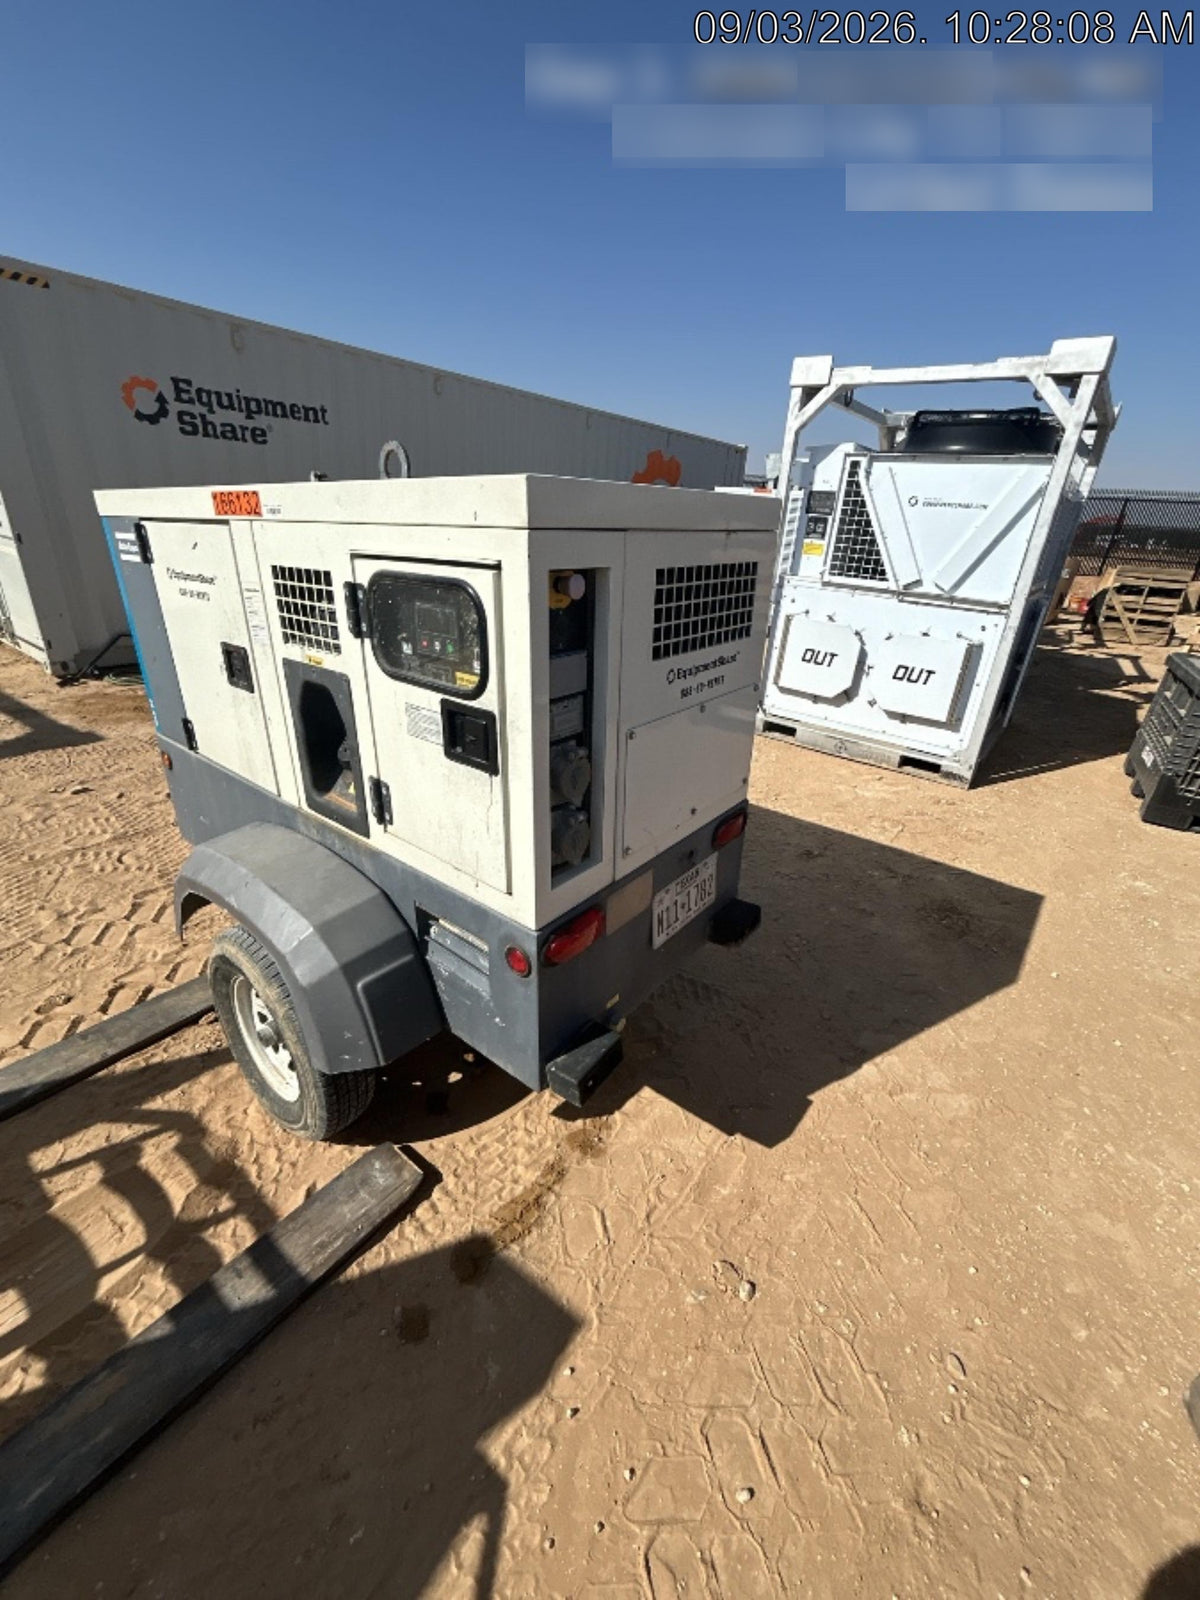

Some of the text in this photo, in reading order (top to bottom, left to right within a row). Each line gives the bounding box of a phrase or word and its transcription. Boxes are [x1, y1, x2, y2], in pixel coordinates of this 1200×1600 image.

[170, 376, 329, 425] Equipment
[801, 648, 838, 667] OUT
[892, 664, 936, 685] OUT
